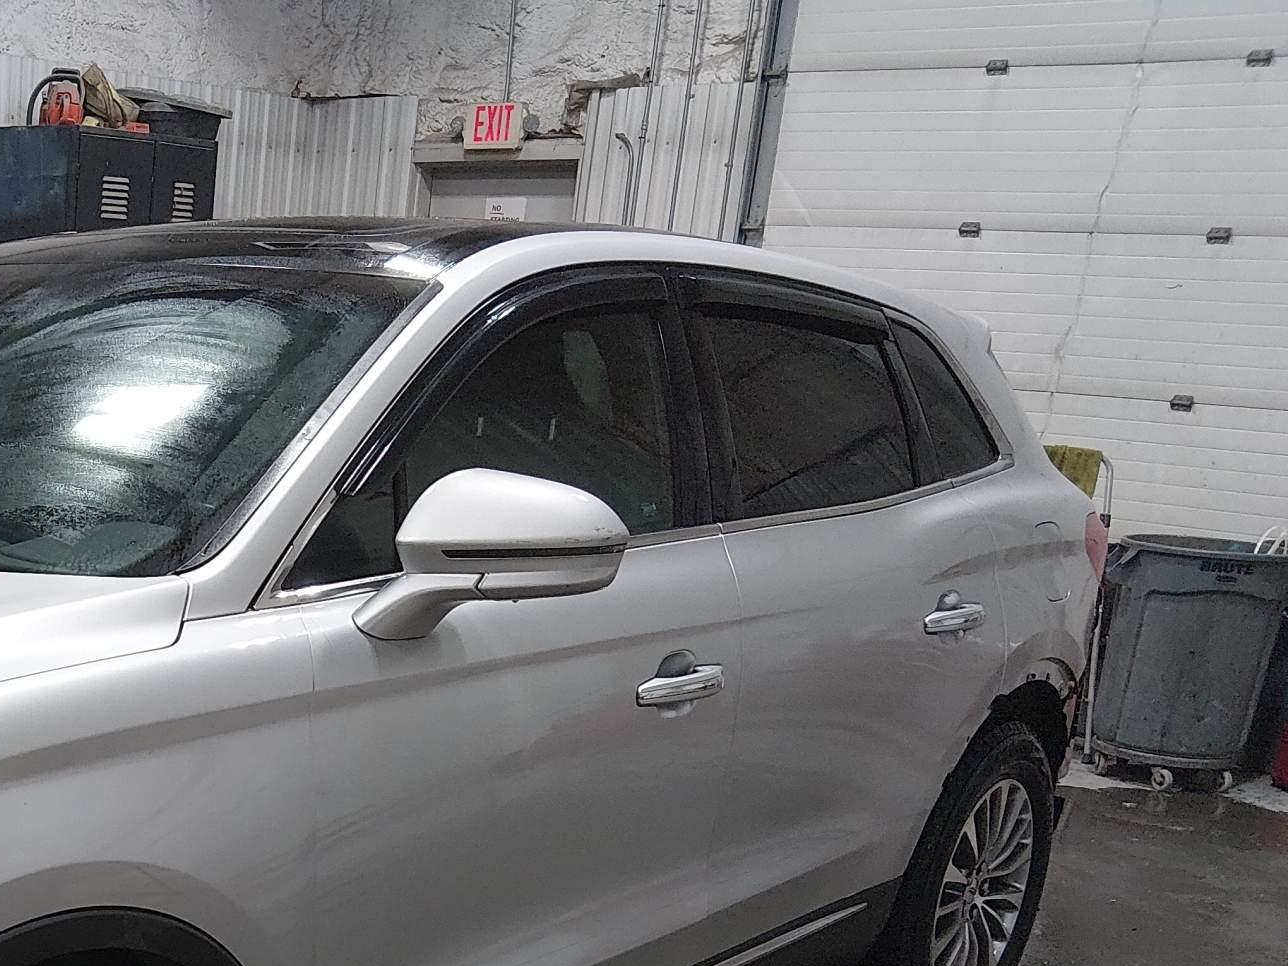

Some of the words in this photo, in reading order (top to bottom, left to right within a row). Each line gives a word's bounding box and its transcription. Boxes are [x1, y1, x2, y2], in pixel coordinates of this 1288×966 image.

[474, 105, 514, 142] EXIT
[491, 204, 502, 212] NO
[1199, 559, 1256, 576] BRUTE
